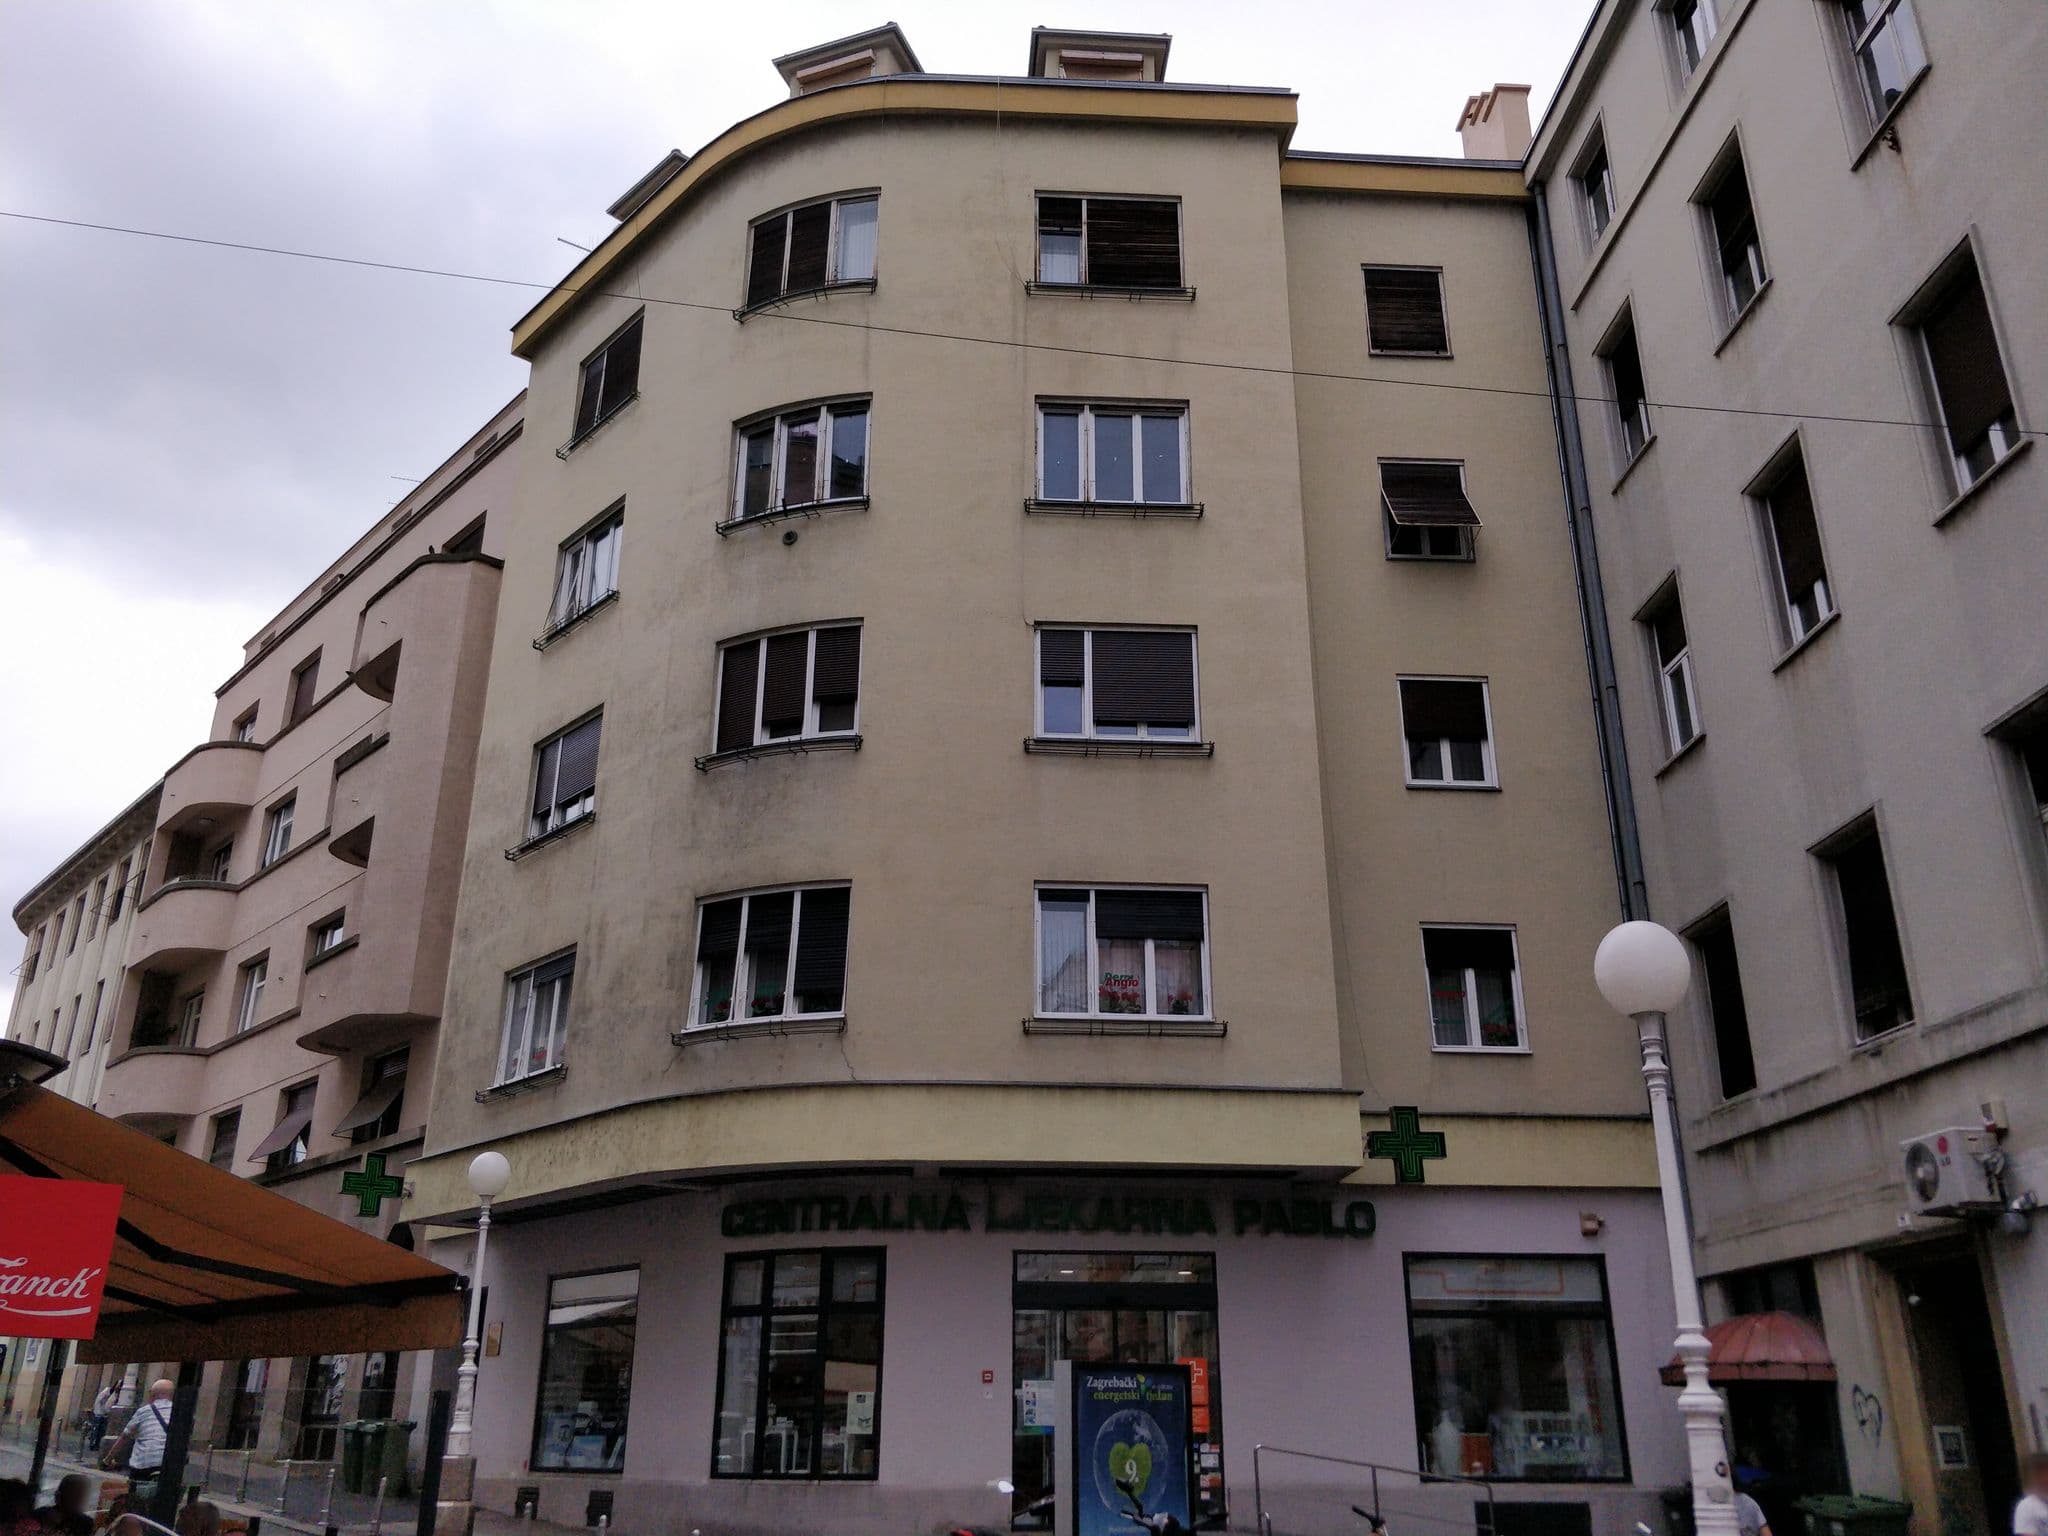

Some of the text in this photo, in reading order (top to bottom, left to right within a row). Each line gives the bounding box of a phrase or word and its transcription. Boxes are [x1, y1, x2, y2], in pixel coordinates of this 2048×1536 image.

[721, 1193, 1377, 1237] CENTRALNA LJEKARNA PABLO
[0, 1257, 101, 1299] anck
